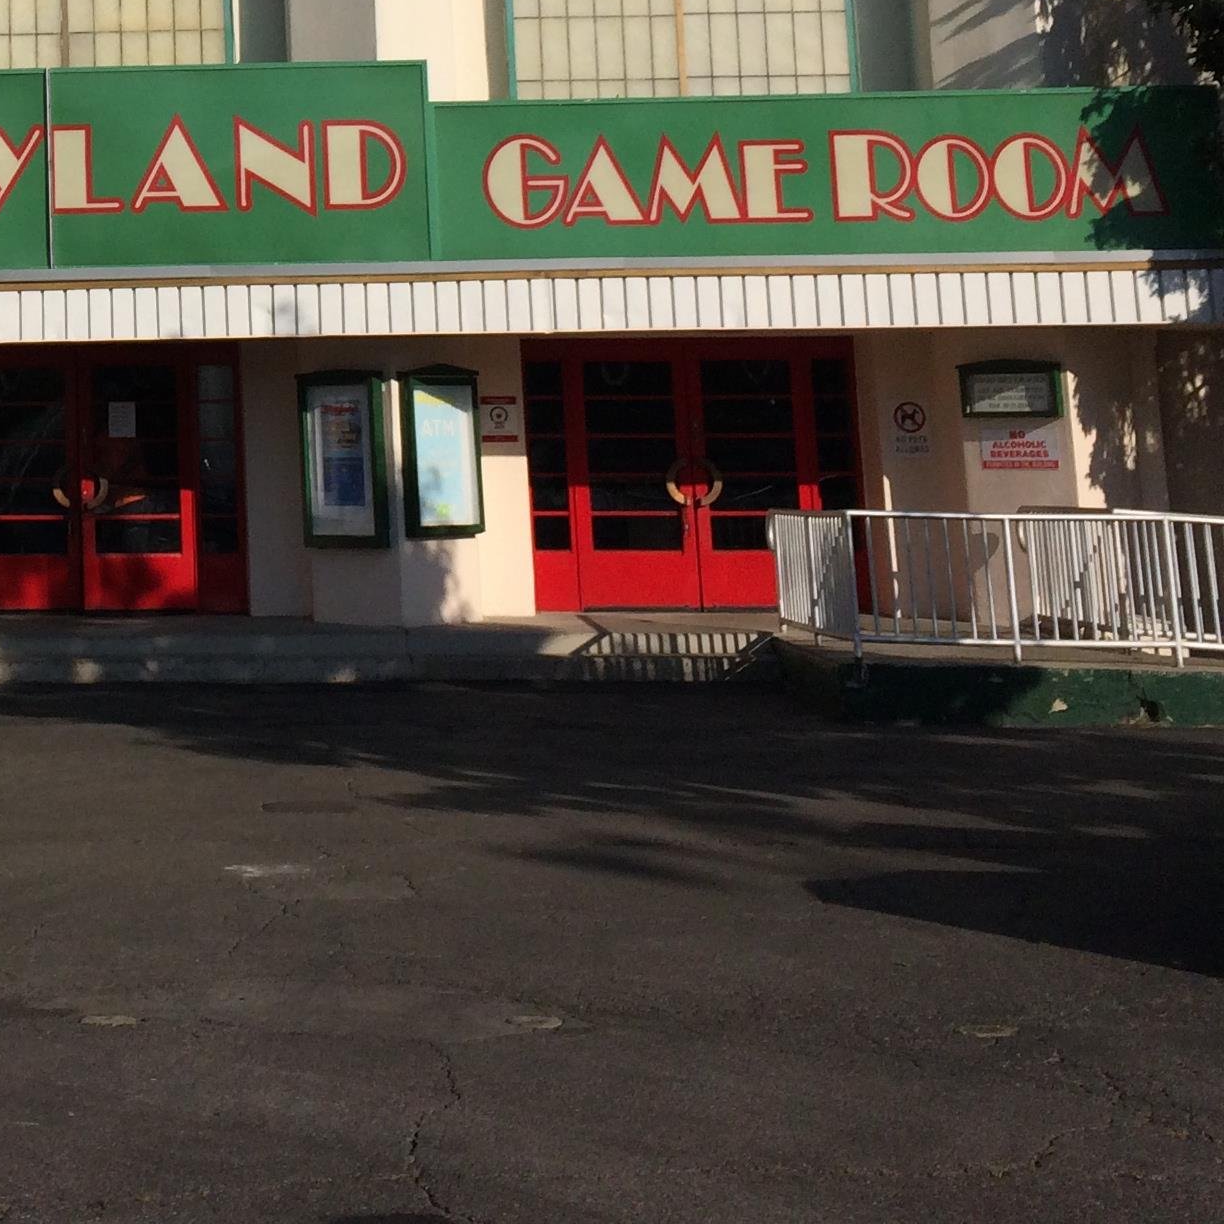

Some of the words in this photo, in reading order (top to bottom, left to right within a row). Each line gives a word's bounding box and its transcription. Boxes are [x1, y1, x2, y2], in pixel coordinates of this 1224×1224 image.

[482, 133, 814, 229] GAME
[828, 125, 1171, 223] ROOM
[422, 418, 456, 437] ATM
[1008, 430, 1026, 439] NO
[992, 440, 1047, 449] ALCOHOLIC
[990, 450, 1049, 458] BEVERAGES
